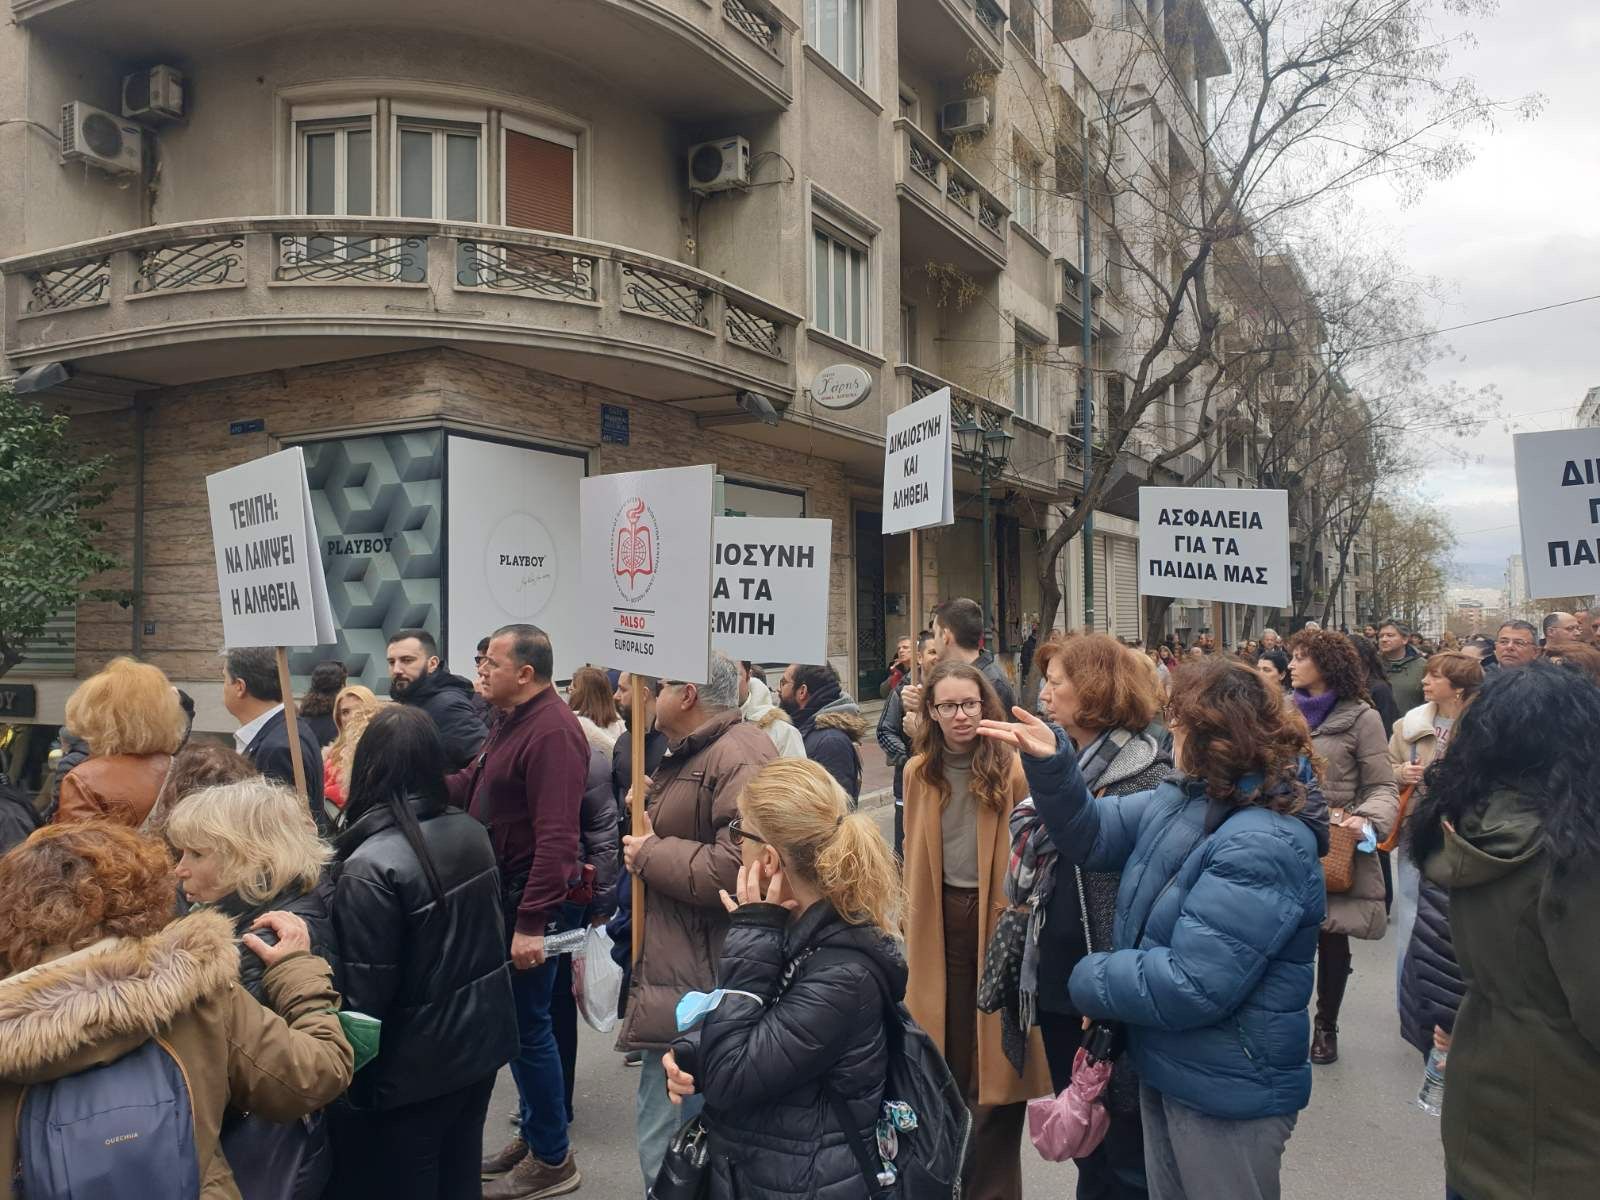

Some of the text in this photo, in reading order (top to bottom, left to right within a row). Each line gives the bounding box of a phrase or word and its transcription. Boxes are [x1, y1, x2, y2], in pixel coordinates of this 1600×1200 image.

[889, 414, 942, 455] ΔΙΚΑΙΟΣΥΝΗ
[903, 454, 918, 478] ΚΑΙ
[1561, 458, 1600, 487] ΔΙ
[893, 481, 929, 510] ΑΛΗΘΕΙΑ
[229, 492, 279, 530] ΤΕΜΠΗ:
[1158, 508, 1263, 529] ΑΣΦΑΛΕΙΑ
[225, 534, 295, 575] ΝΑ ΛΑΜΨΕΙ
[327, 538, 393, 556] PLAYBOY
[715, 543, 815, 568] ΙΟΣΥΝΗ
[1174, 535, 1239, 556] ΓΙΑ ΤΑ
[499, 554, 545, 567] PLAYBOY
[1149, 559, 1268, 585] ΠΑΙΔΙΑ ΜΑΣ
[231, 581, 300, 615] Η ΑΛΗΘΕΙΑ
[713, 577, 772, 601] Α ΤΑ
[620, 614, 645, 630] PALSO
[614, 638, 654, 656] EUROPALSO
